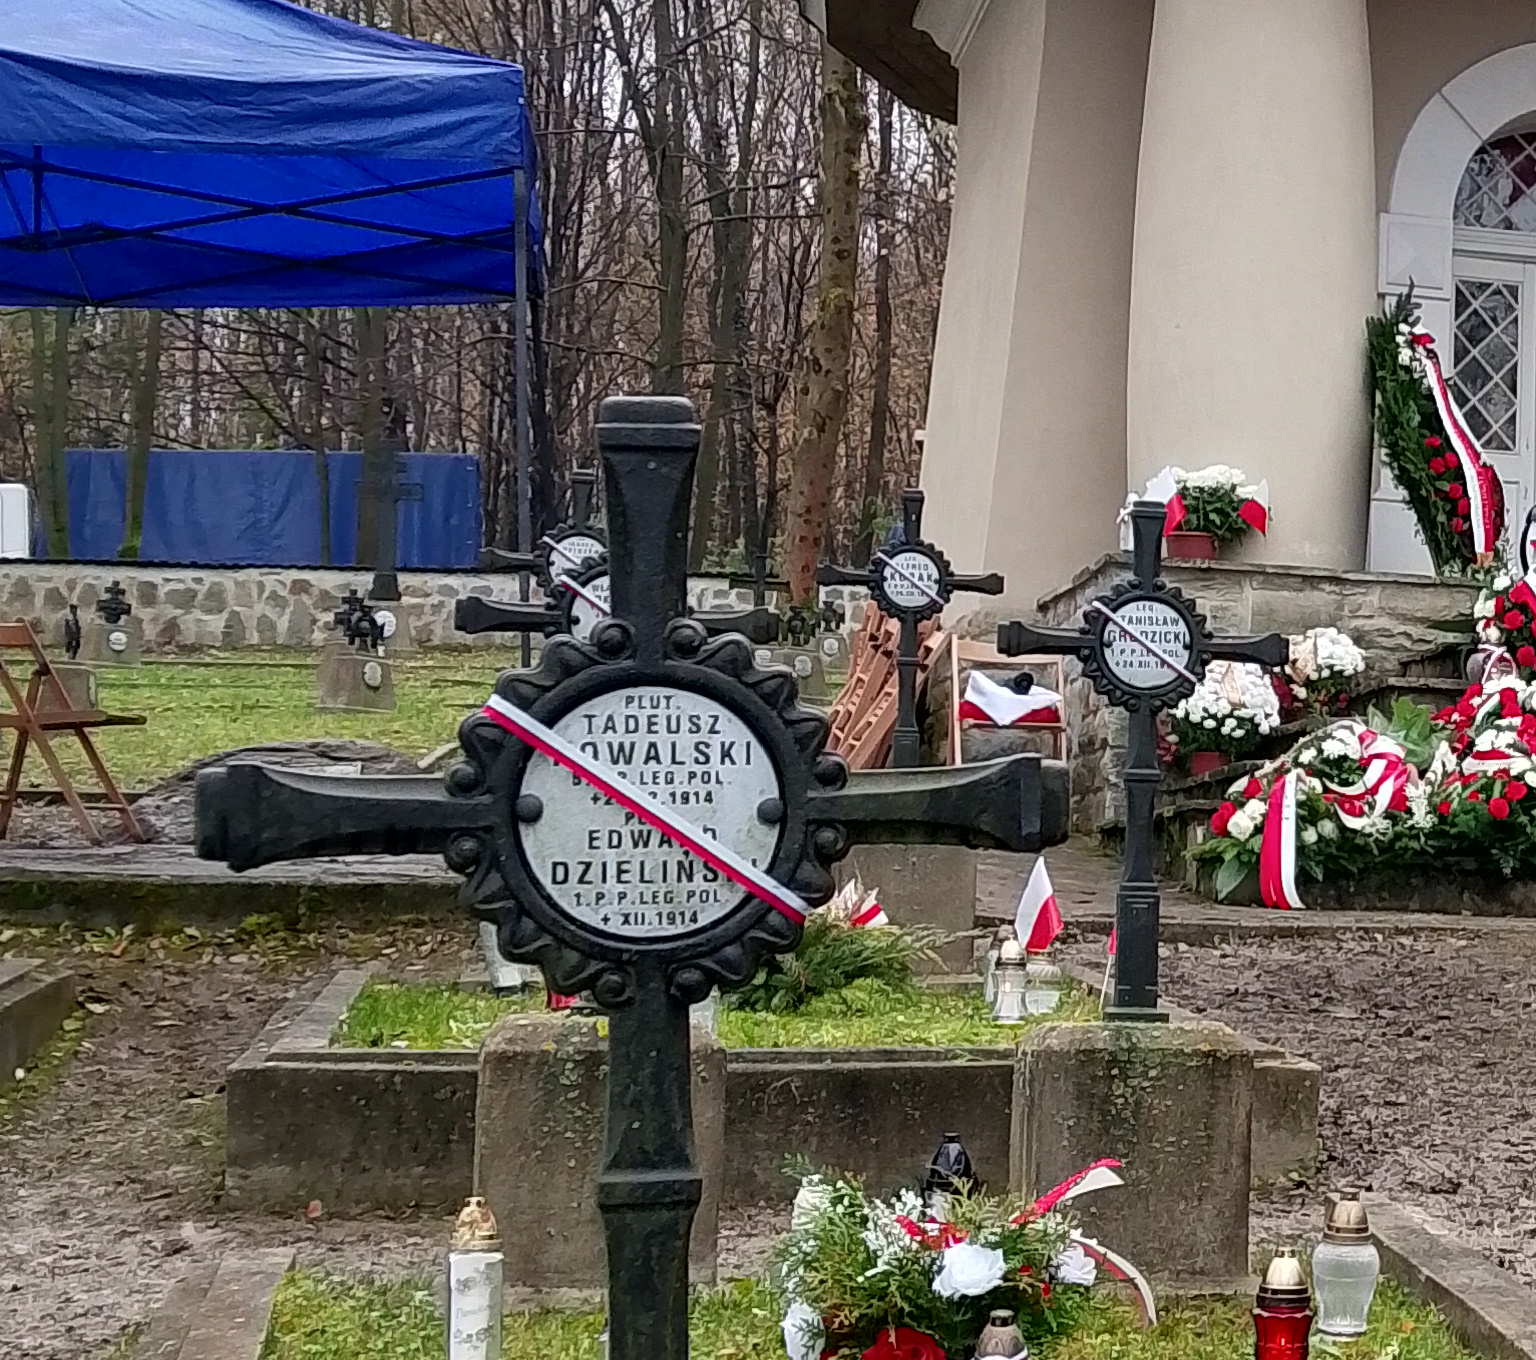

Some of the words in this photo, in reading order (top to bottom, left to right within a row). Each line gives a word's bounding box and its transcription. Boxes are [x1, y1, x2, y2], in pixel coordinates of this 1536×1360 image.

[1116, 614, 1180, 627] TANISŁAW
[1107, 629, 1186, 645] GRDZICKI
[624, 694, 682, 710] PLUT.
[581, 713, 722, 735] TADEUSZ
[553, 740, 752, 766] OWALSKI
[587, 824, 718, 850] EDWA
[551, 849, 759, 886] DZIELIŃS
